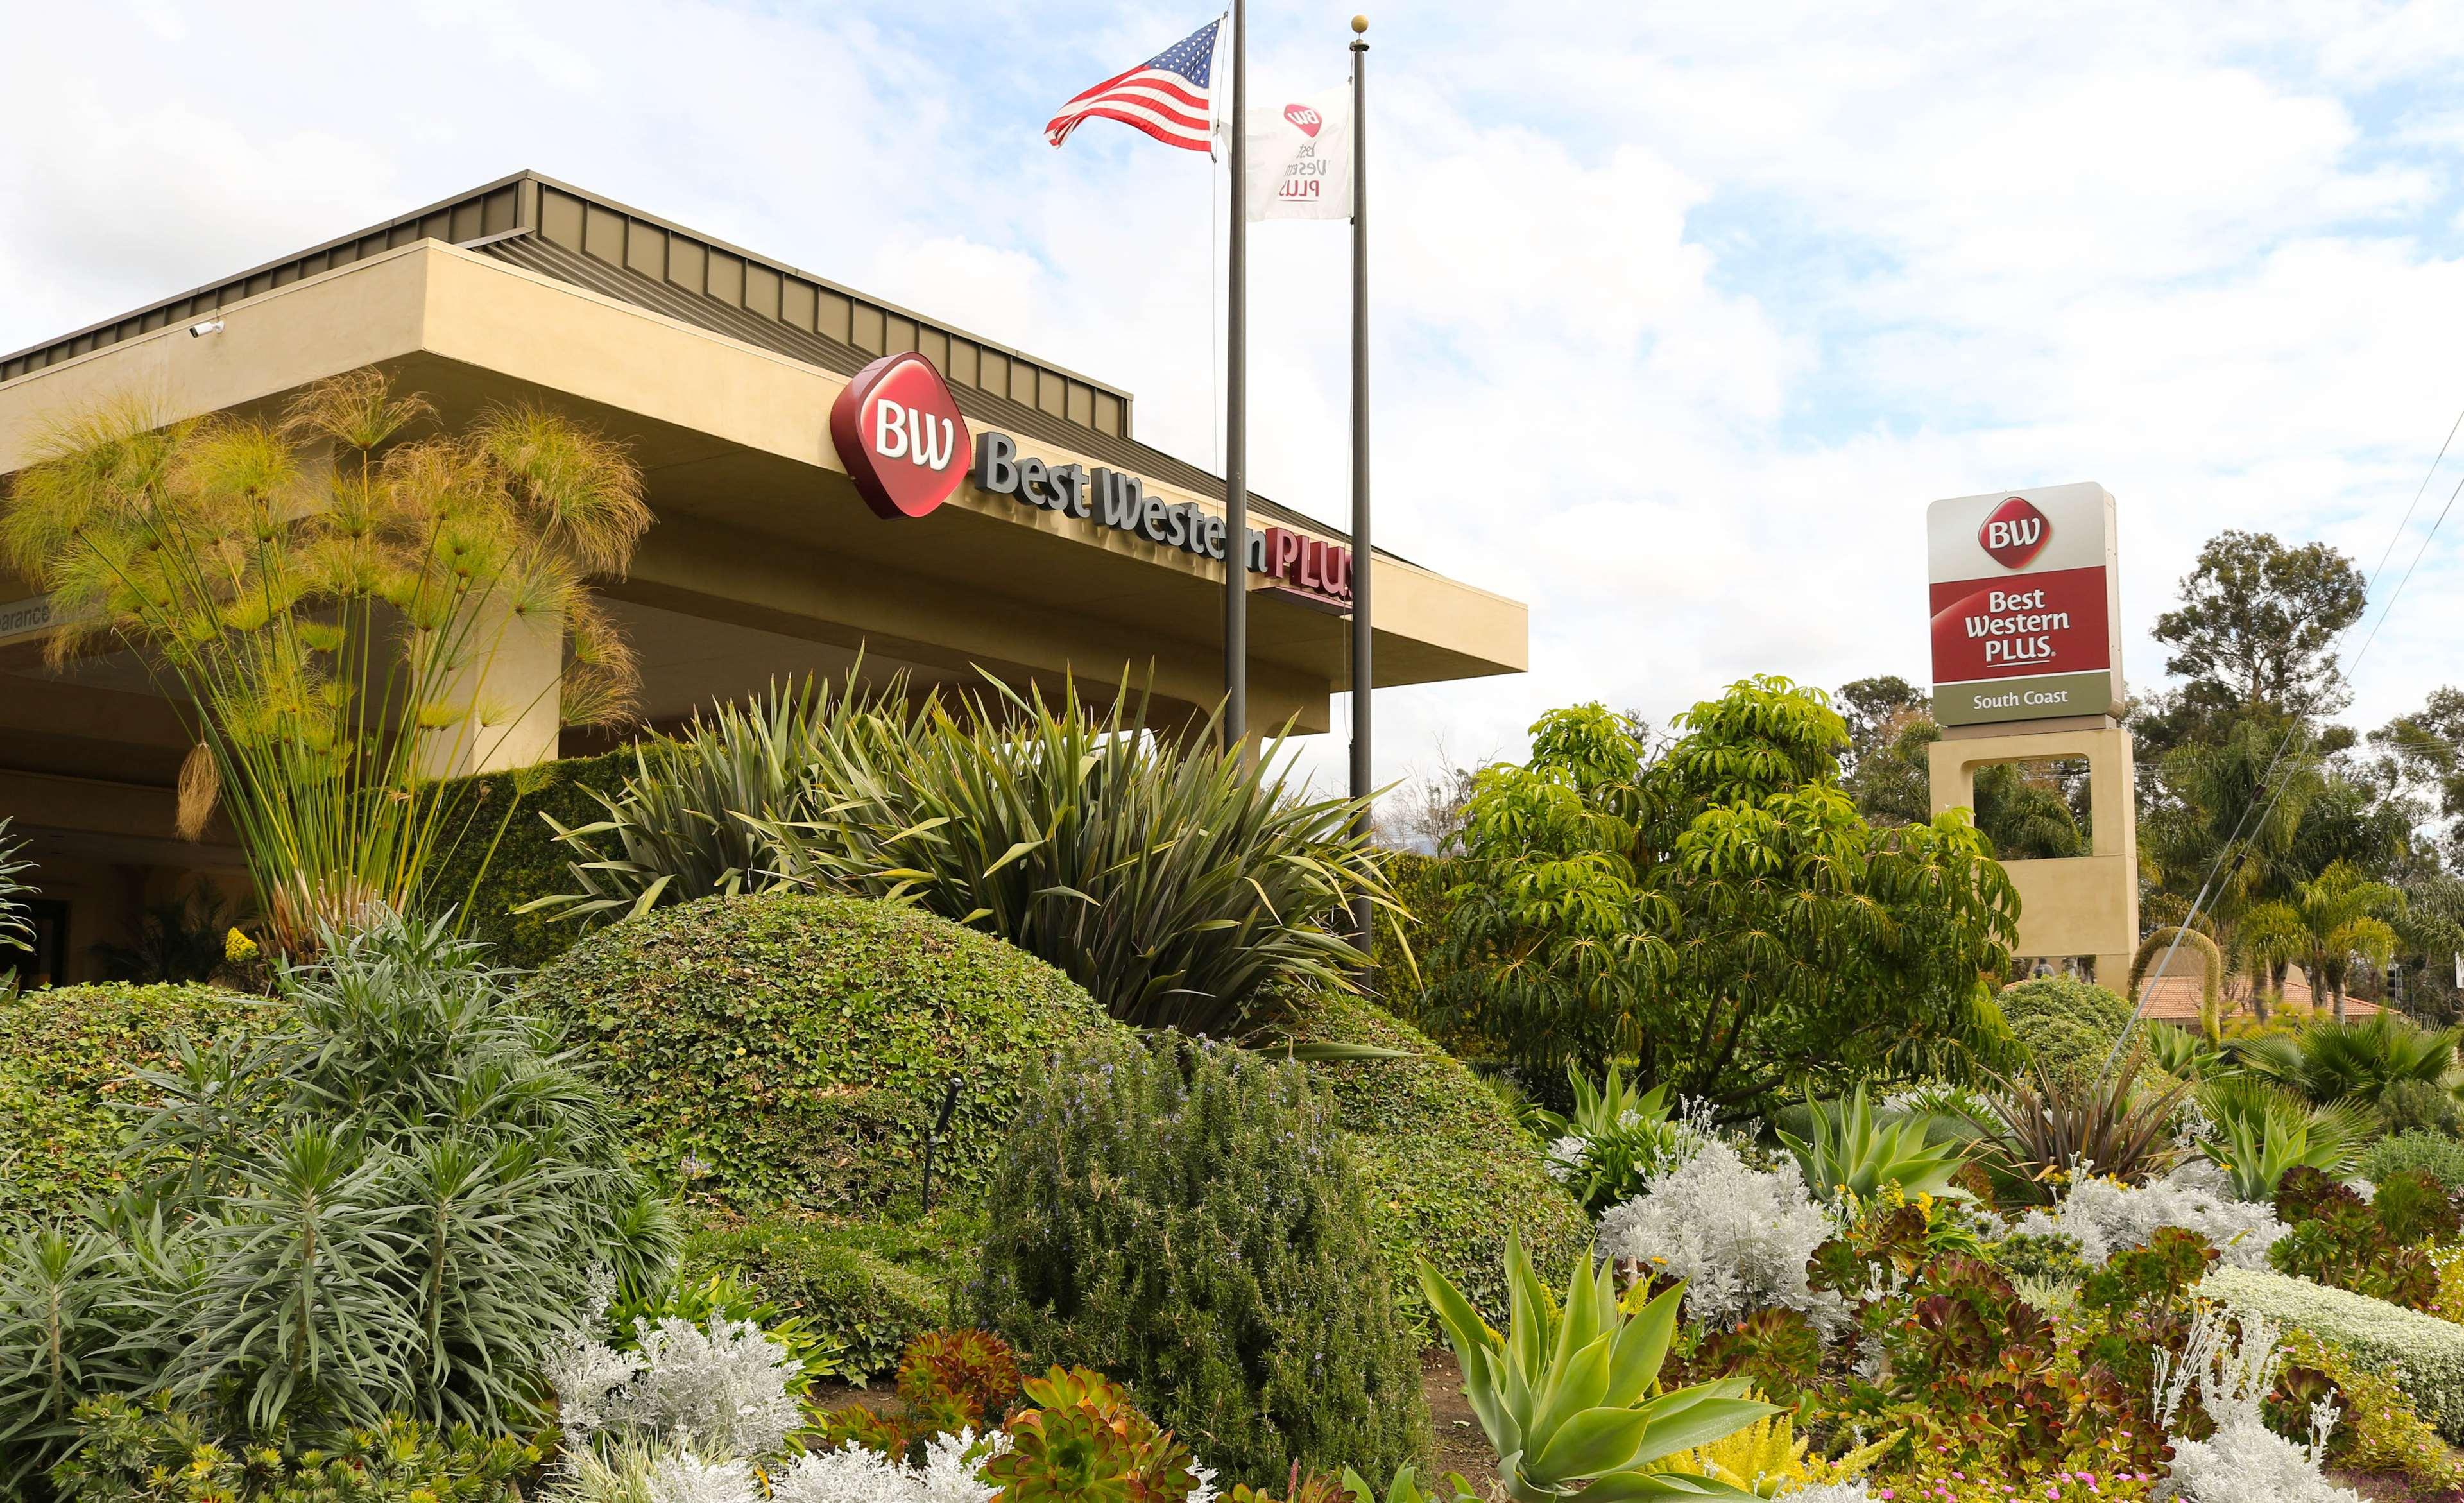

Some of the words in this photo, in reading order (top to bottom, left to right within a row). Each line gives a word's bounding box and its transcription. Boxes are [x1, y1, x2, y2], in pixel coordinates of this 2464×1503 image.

[877, 399, 954, 471] BW
[977, 431, 1091, 519] Best
[1091, 467, 1268, 573] Westen
[1266, 527, 1353, 601] PLU
[1989, 517, 2041, 549] BW
[1989, 589, 2046, 613] Best
[0, 605, 50, 631] arance
[1965, 612, 2070, 638] Western
[1973, 692, 2019, 709] South
[2024, 690, 2068, 705] Coast
